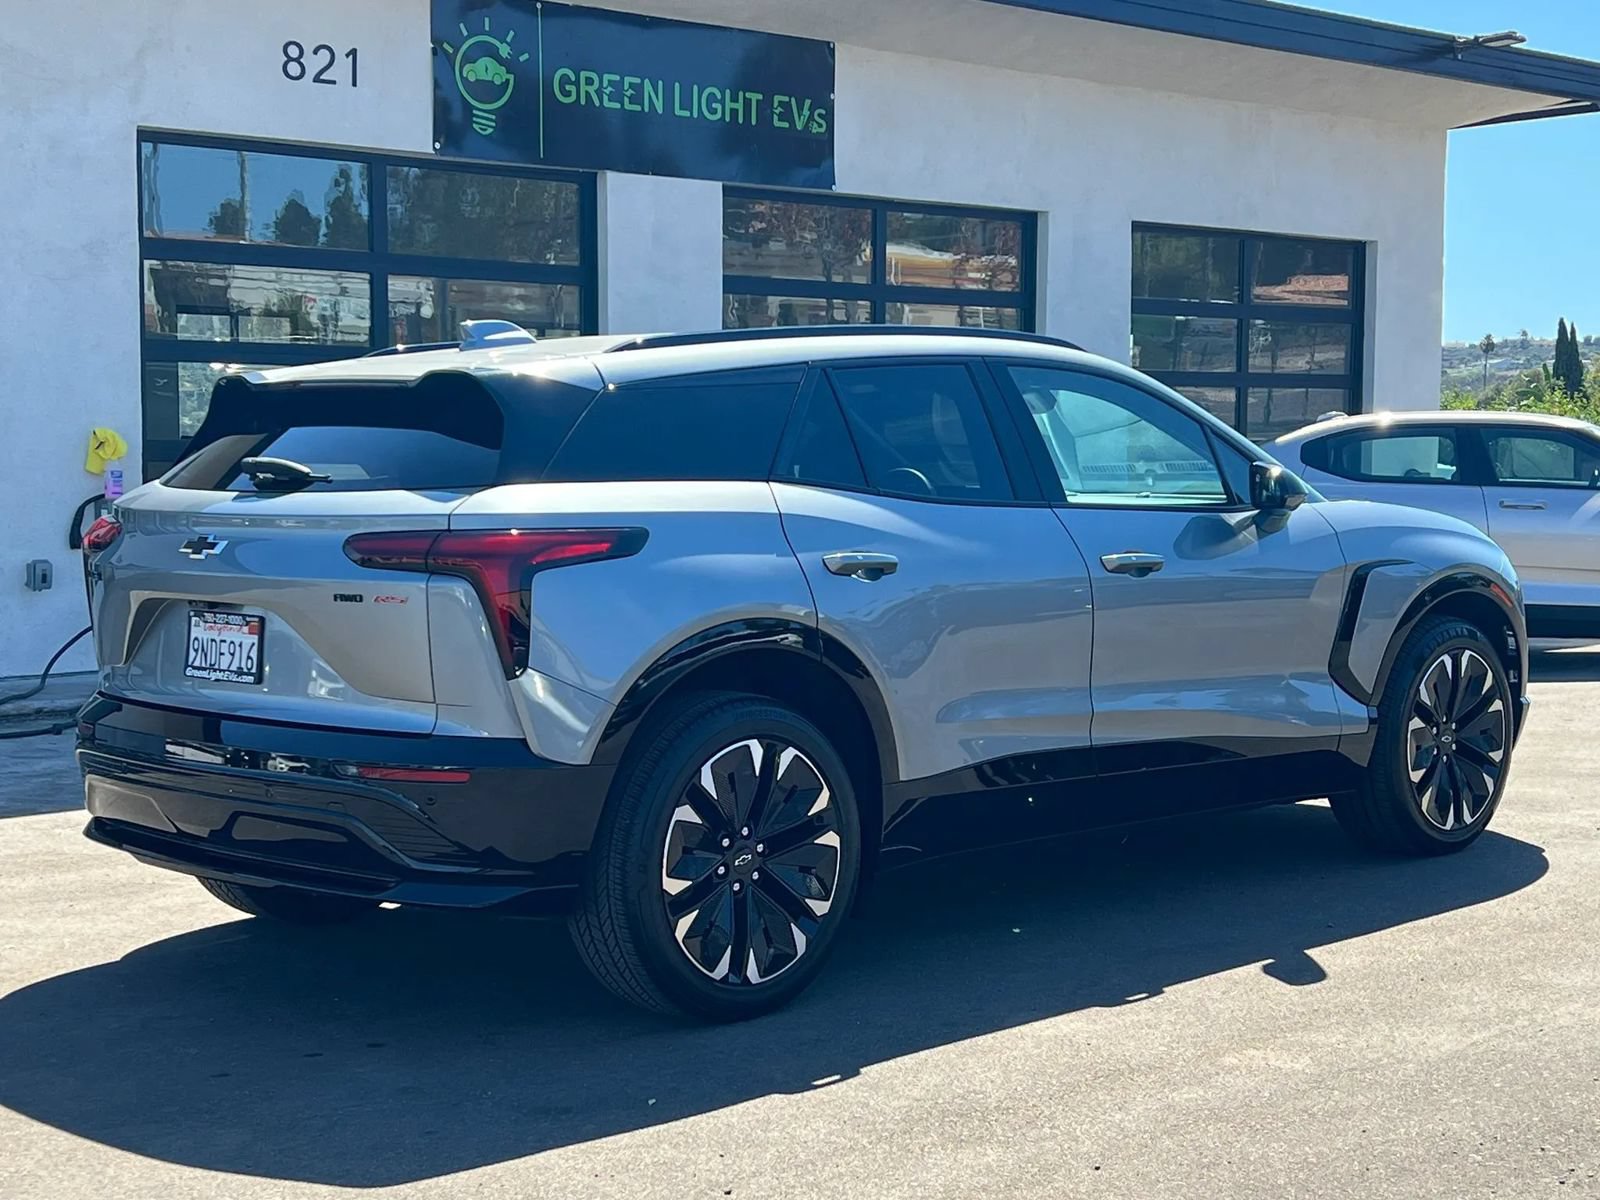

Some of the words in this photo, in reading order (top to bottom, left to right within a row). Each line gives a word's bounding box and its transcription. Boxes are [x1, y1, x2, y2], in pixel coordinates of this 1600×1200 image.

[282, 40, 357, 88] 821
[552, 67, 663, 114] GREEN
[674, 81, 763, 125] LIGHT
[191, 636, 256, 672] 9NDF916
